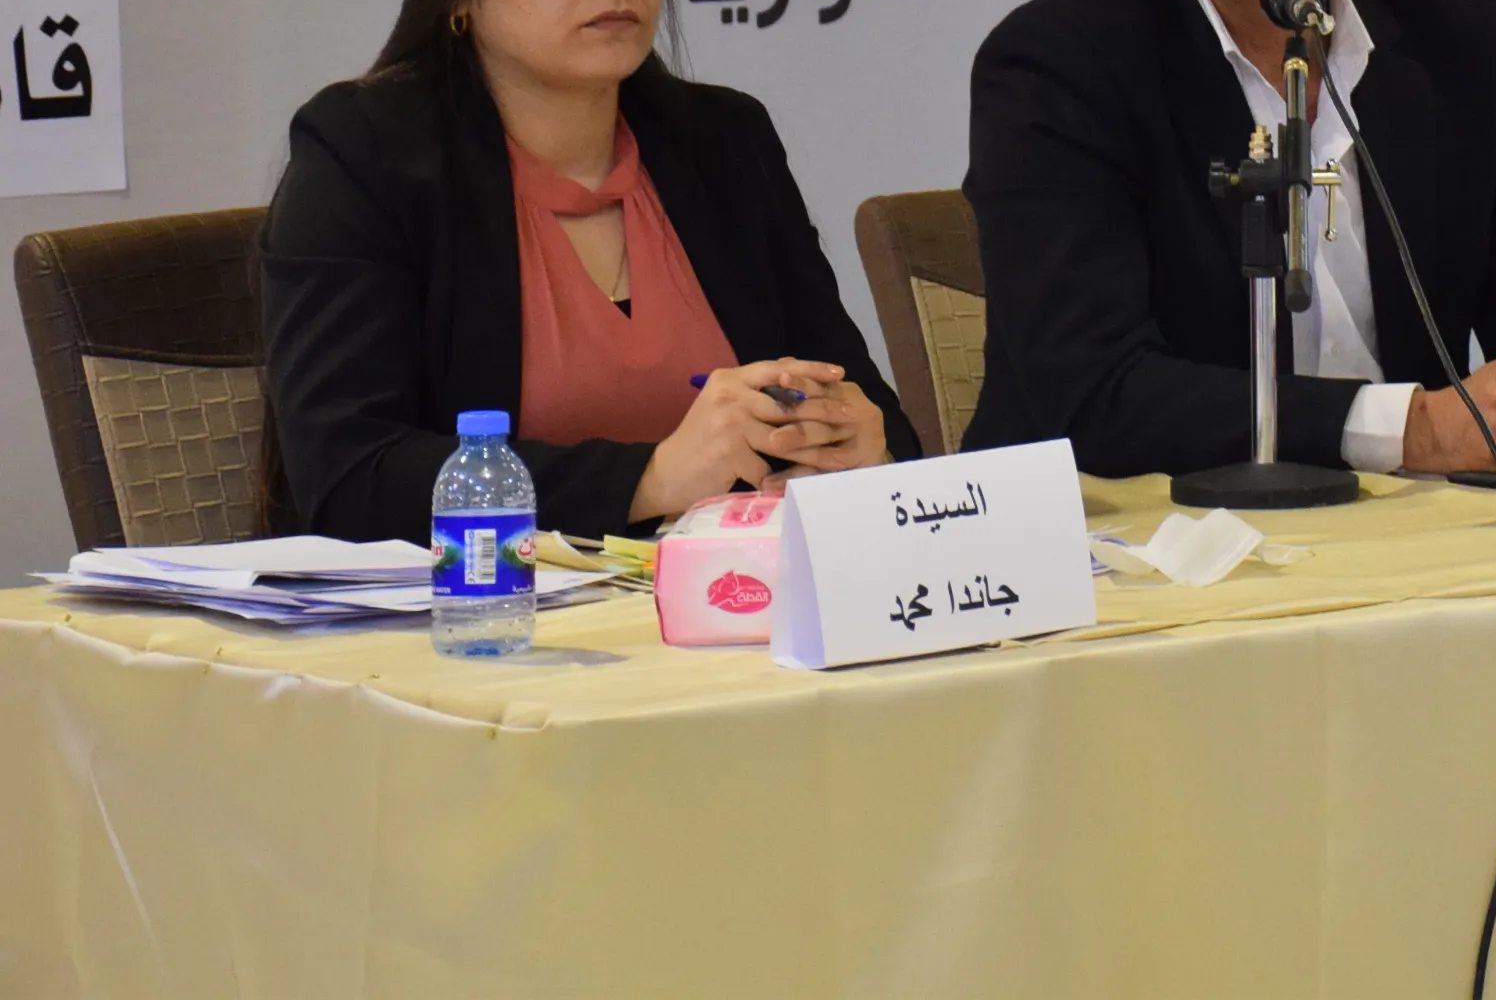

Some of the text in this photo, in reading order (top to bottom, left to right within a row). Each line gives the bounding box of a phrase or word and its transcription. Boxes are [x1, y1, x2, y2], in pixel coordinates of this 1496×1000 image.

[891, 482, 986, 533] السيدة
[890, 575, 1019, 631] جاندا محمد
